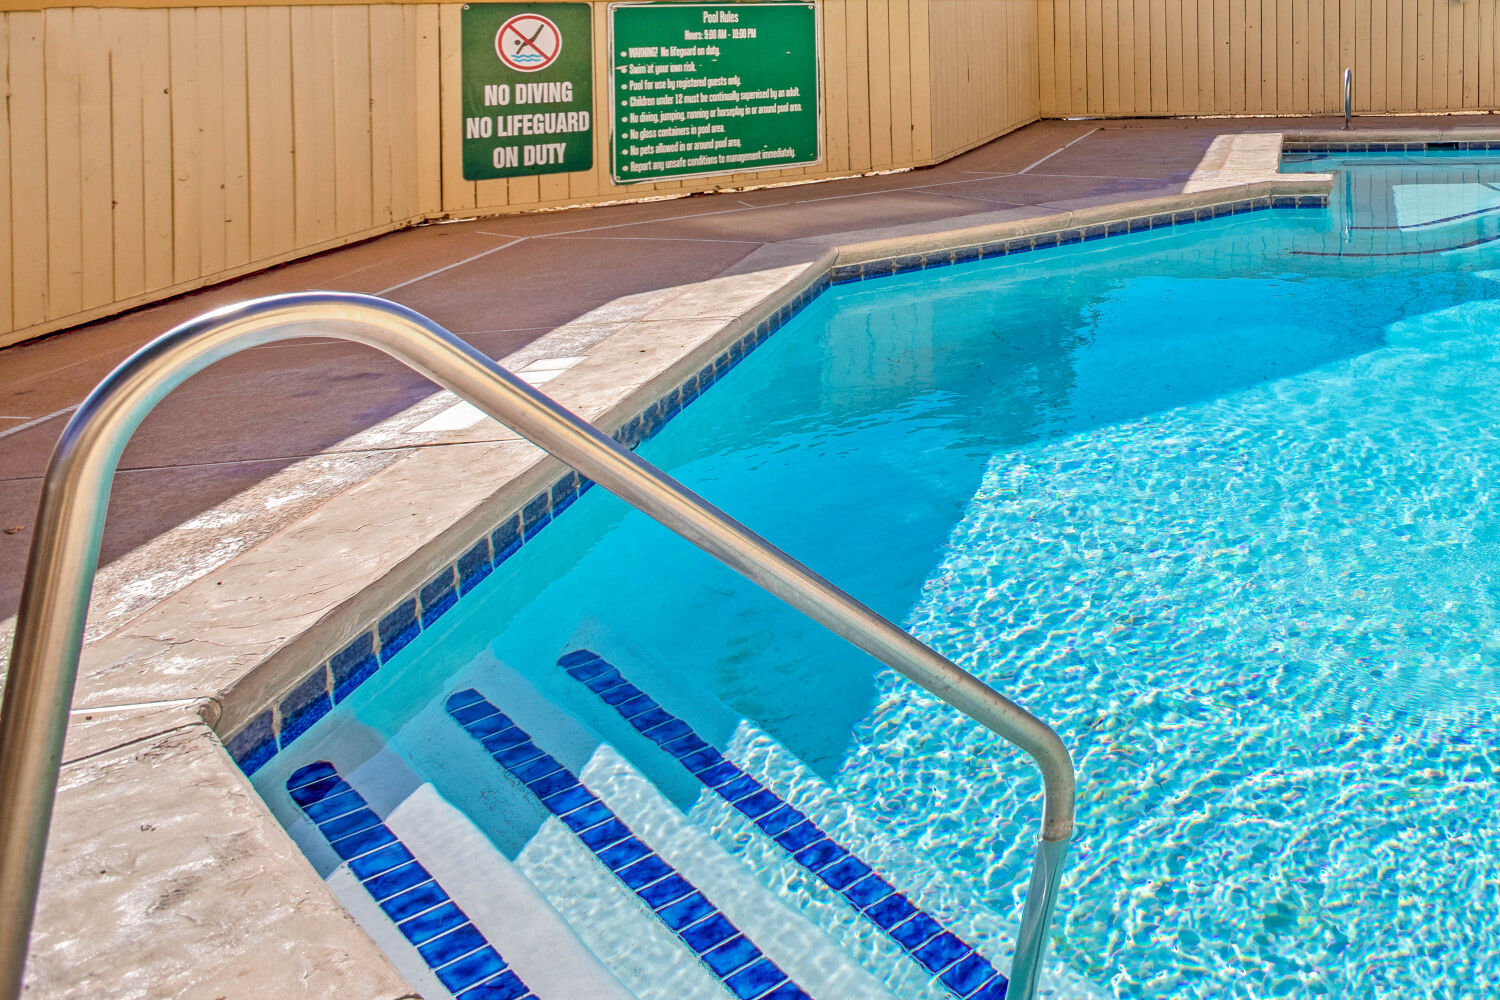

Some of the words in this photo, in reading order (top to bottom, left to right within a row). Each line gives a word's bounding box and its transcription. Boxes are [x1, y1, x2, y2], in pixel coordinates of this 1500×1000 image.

[702, 10, 718, 23] Pool
[719, 10, 739, 23] Rules
[684, 30, 703, 40] Hours:
[718, 29, 727, 39] AM
[732, 28, 747, 39] 10:00
[747, 28, 756, 38] PM
[628, 47, 658, 58] WARNING!
[660, 46, 669, 57] No
[670, 45, 697, 58] lifeguard
[697, 47, 705, 55] on
[706, 45, 721, 57] duty.
[629, 63, 646, 74] Swim
[647, 64, 654, 73] at
[655, 65, 669, 75] your
[670, 64, 682, 73] own
[683, 61, 697, 72] risk.
[629, 80, 643, 90] Pool
[644, 80, 653, 90] for
[654, 81, 666, 89] use
[667, 78, 675, 90] by
[676, 76, 707, 90] registered
[707, 76, 727, 88] guests
[728, 75, 742, 86] only.
[484, 84, 510, 106] NO
[515, 82, 572, 104] DIVING
[630, 96, 655, 107] Children
[656, 94, 674, 105] under
[675, 94, 683, 104] 12
[684, 93, 699, 104] must
[700, 92, 708, 103] be
[709, 90, 740, 102] continually
[741, 88, 769, 101] supervised
[770, 88, 777, 100] by
[778, 90, 785, 98] an
[786, 87, 800, 97] adult.
[630, 113, 638, 123] No
[640, 112, 659, 123] diving,
[660, 110, 686, 123] jumping,
[686, 108, 709, 120] running
[716, 105, 744, 118] horseplay
[745, 105, 751, 115] in
[751, 106, 757, 115] or
[758, 103, 776, 114] around
[777, 102, 789, 114] pool
[790, 104, 802, 112] area.
[466, 116, 492, 139] NO
[497, 111, 590, 137] LIFEGUARD
[630, 129, 639, 140] No
[640, 128, 657, 140] glass
[657, 125, 690, 137] containers
[690, 125, 696, 135] in
[697, 123, 711, 138] pool
[711, 124, 725, 133] area.
[493, 146, 518, 168] ON
[524, 143, 566, 166] DUTY
[630, 145, 639, 156] No
[640, 145, 655, 157] pets
[655, 142, 679, 154] allowed
[679, 141, 685, 151] in
[686, 143, 693, 151] or
[693, 138, 714, 150] around
[714, 137, 727, 150] pool
[728, 139, 742, 148] area.
[630, 161, 652, 173] Report
[652, 161, 665, 171] any
[665, 157, 686, 169] unsafe
[687, 155, 718, 167] conditions
[718, 154, 725, 164] to
[726, 151, 761, 163] management
[762, 147, 796, 159] immediately.
